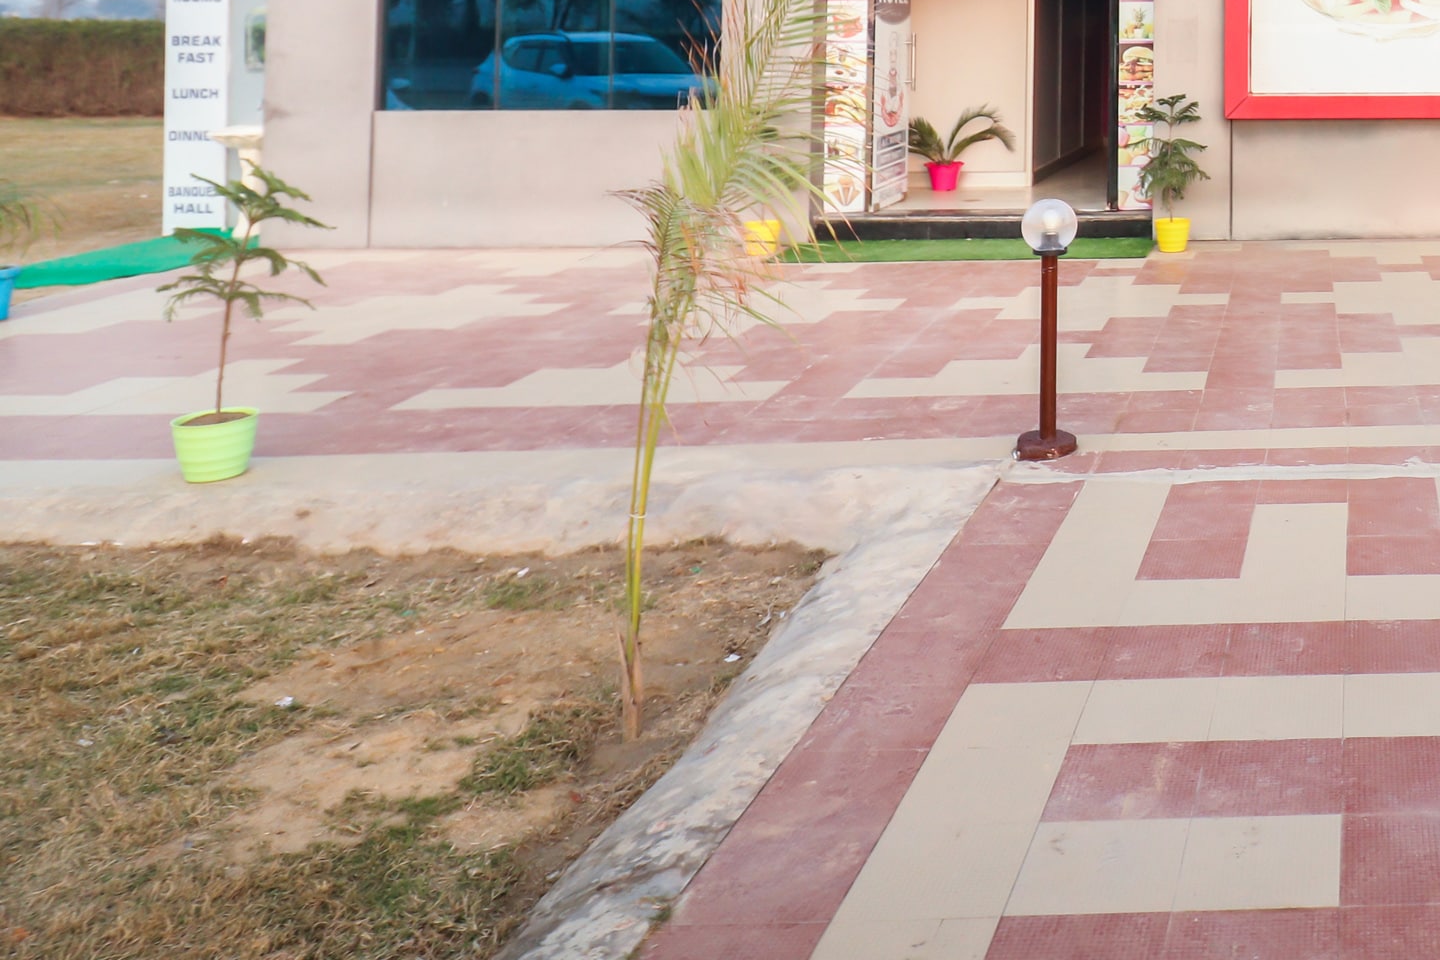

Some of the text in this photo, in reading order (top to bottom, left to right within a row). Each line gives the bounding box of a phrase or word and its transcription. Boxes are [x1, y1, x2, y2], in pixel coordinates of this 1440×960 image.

[171, 35, 221, 47] BREAK
[178, 52, 215, 63] FAST
[172, 88, 219, 99] LUNCH
[168, 130, 211, 142] DINNE
[168, 186, 215, 197] BANQUE
[174, 203, 213, 214] HALL
